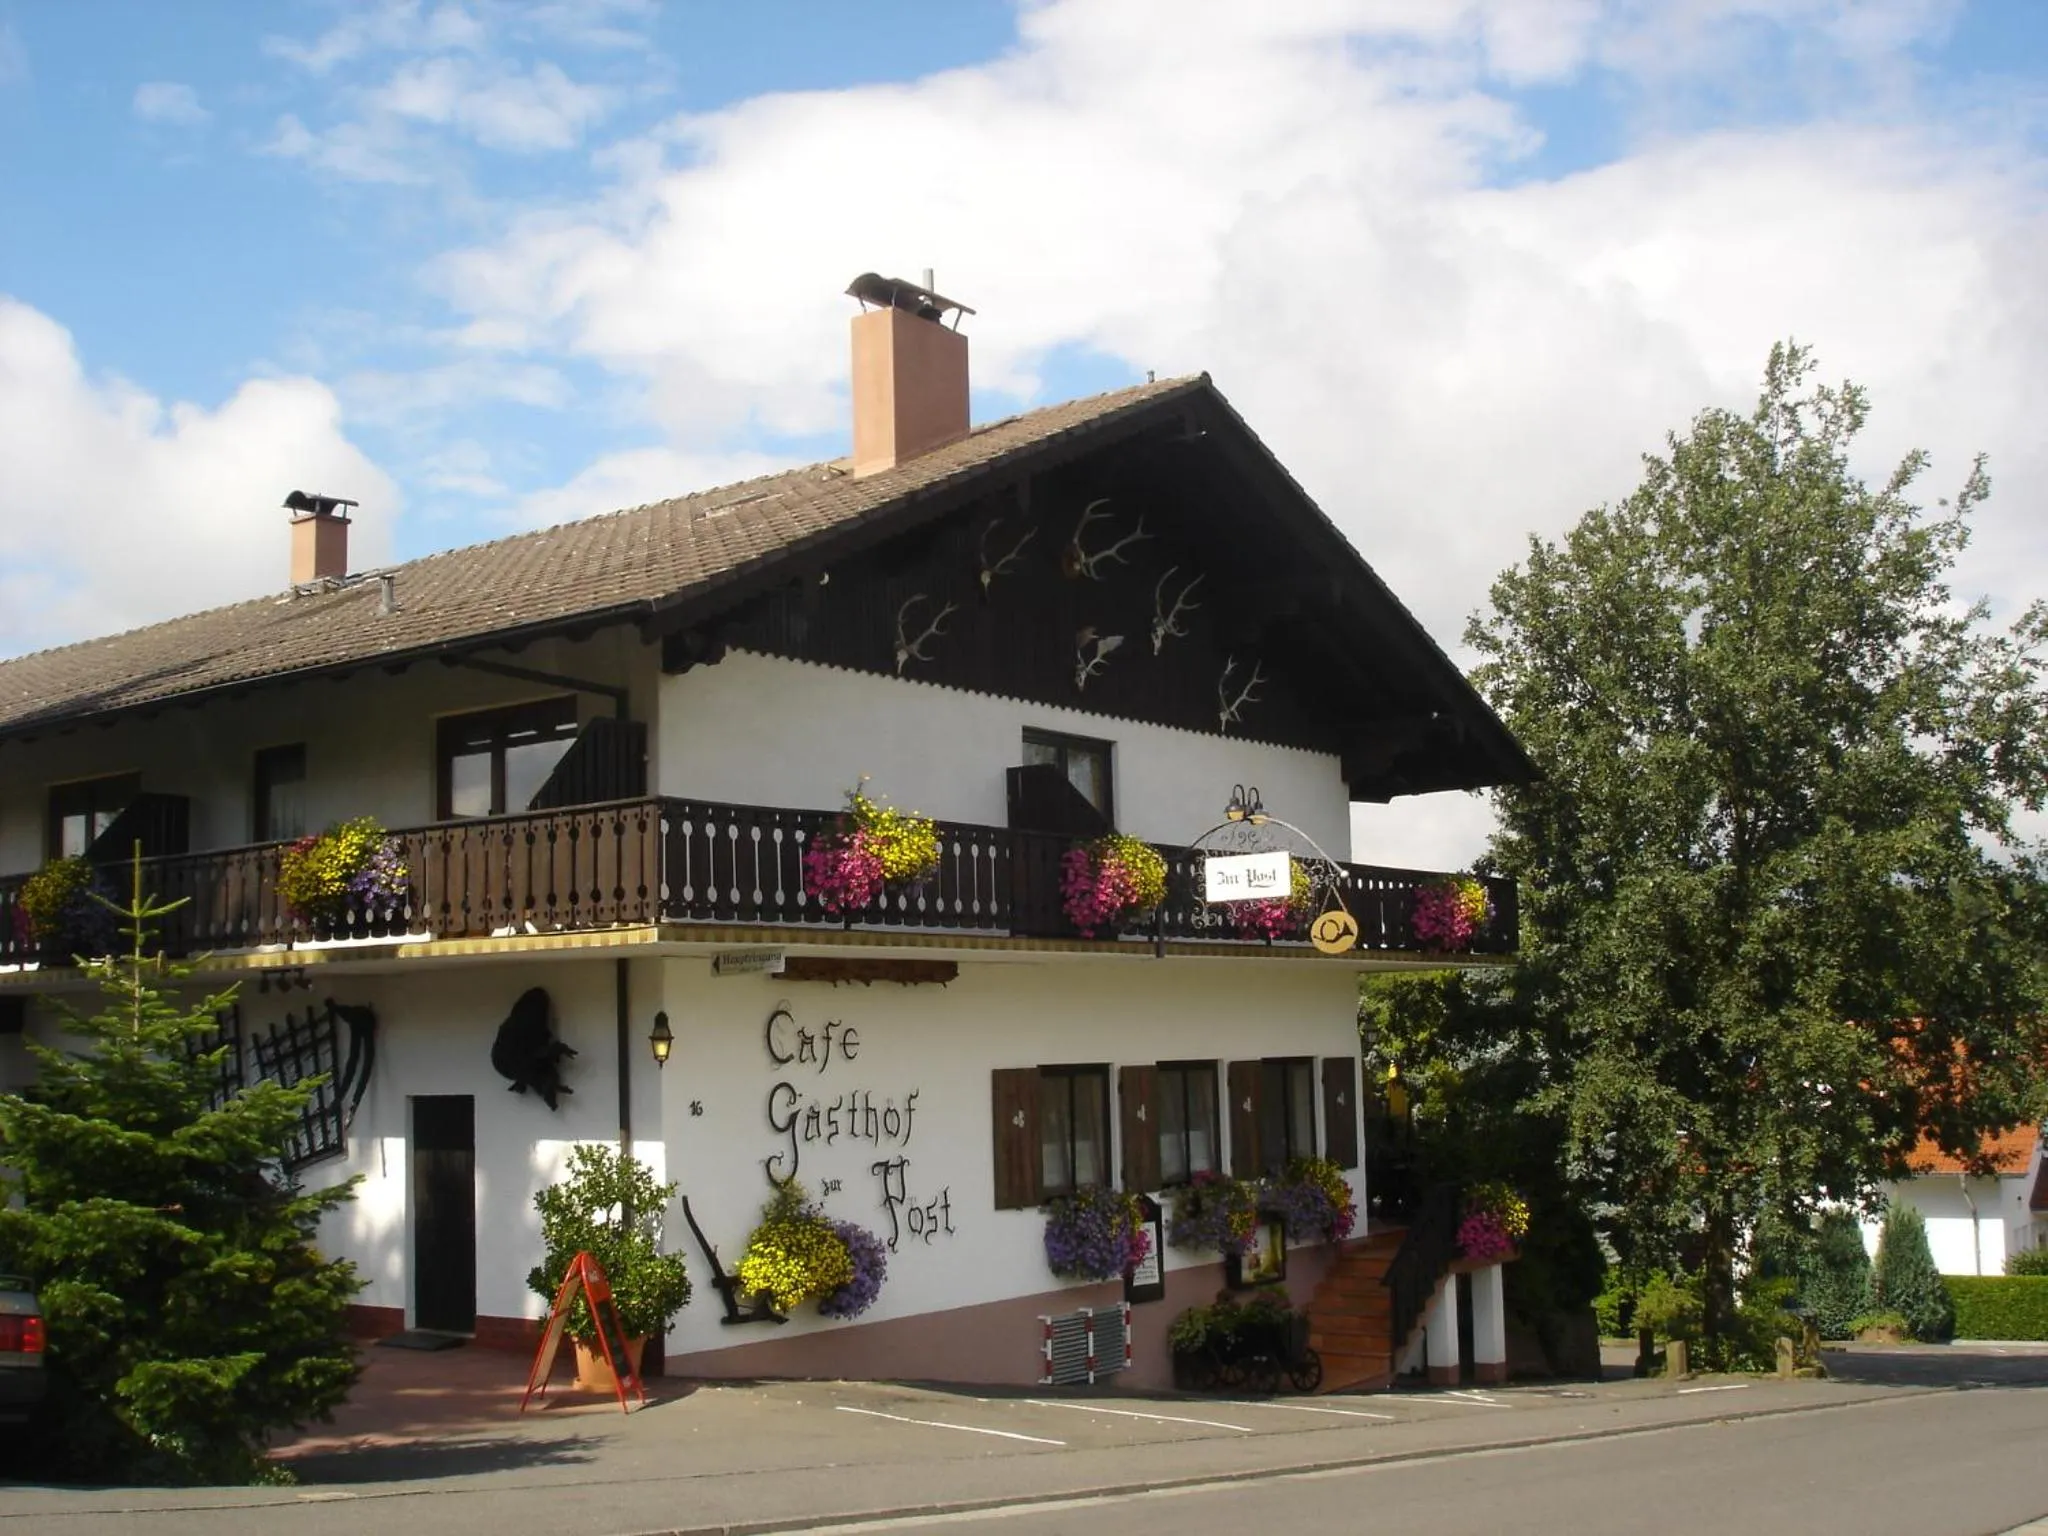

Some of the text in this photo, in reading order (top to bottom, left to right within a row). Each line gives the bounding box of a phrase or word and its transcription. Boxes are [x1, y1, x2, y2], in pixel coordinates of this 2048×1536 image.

[1246, 868, 1277, 888] Post
[766, 1008, 860, 1073] Cafe
[689, 1100, 703, 1116] 16
[766, 1081, 919, 1188] Gasthof
[872, 1156, 955, 1252] Post
